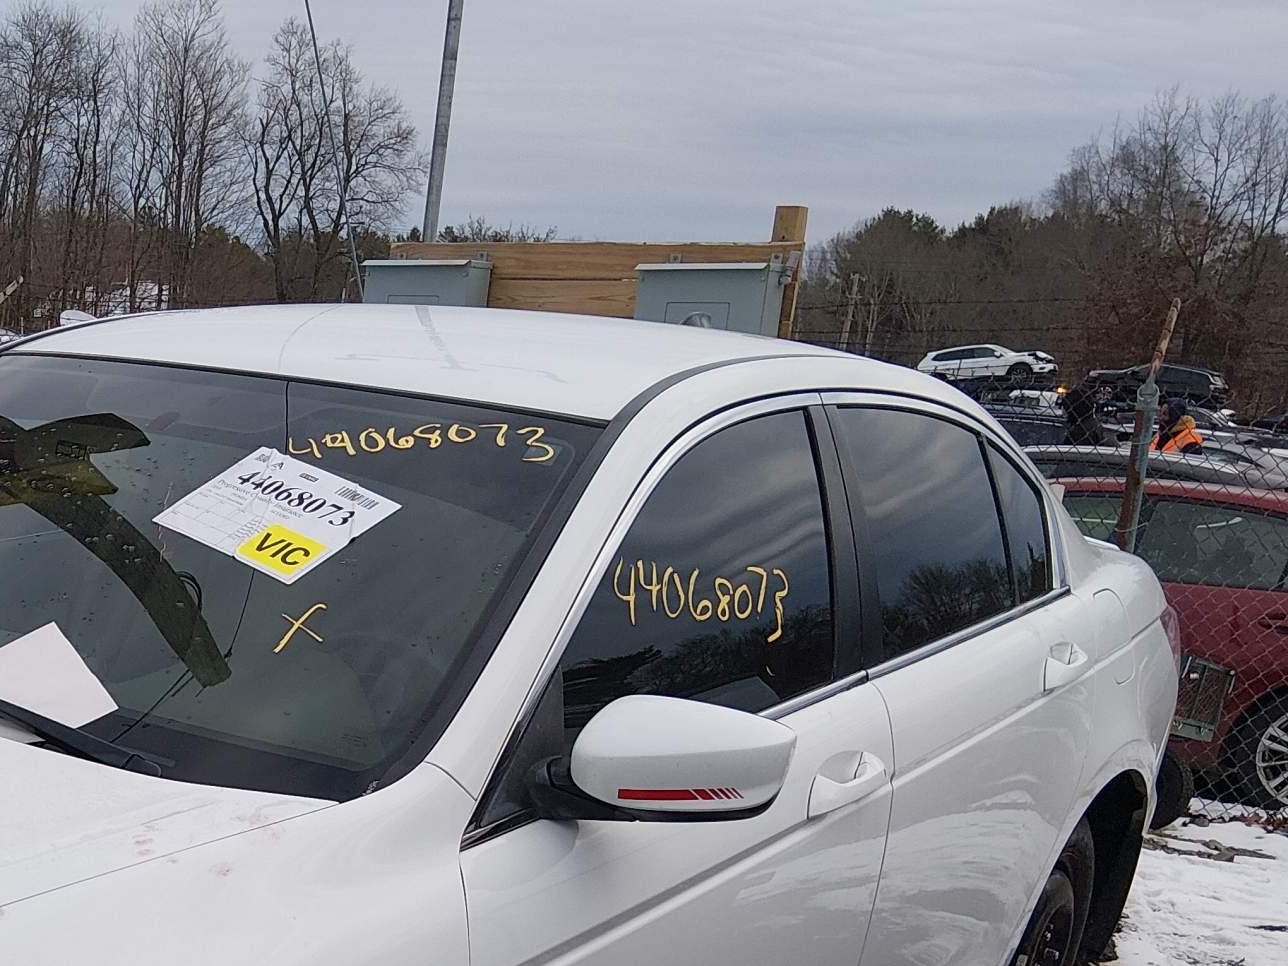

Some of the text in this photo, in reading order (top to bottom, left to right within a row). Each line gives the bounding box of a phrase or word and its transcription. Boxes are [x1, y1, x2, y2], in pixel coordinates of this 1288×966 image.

[237, 471, 356, 527] 44068073
[255, 532, 311, 566] VIC
[614, 556, 789, 643] 44068073
